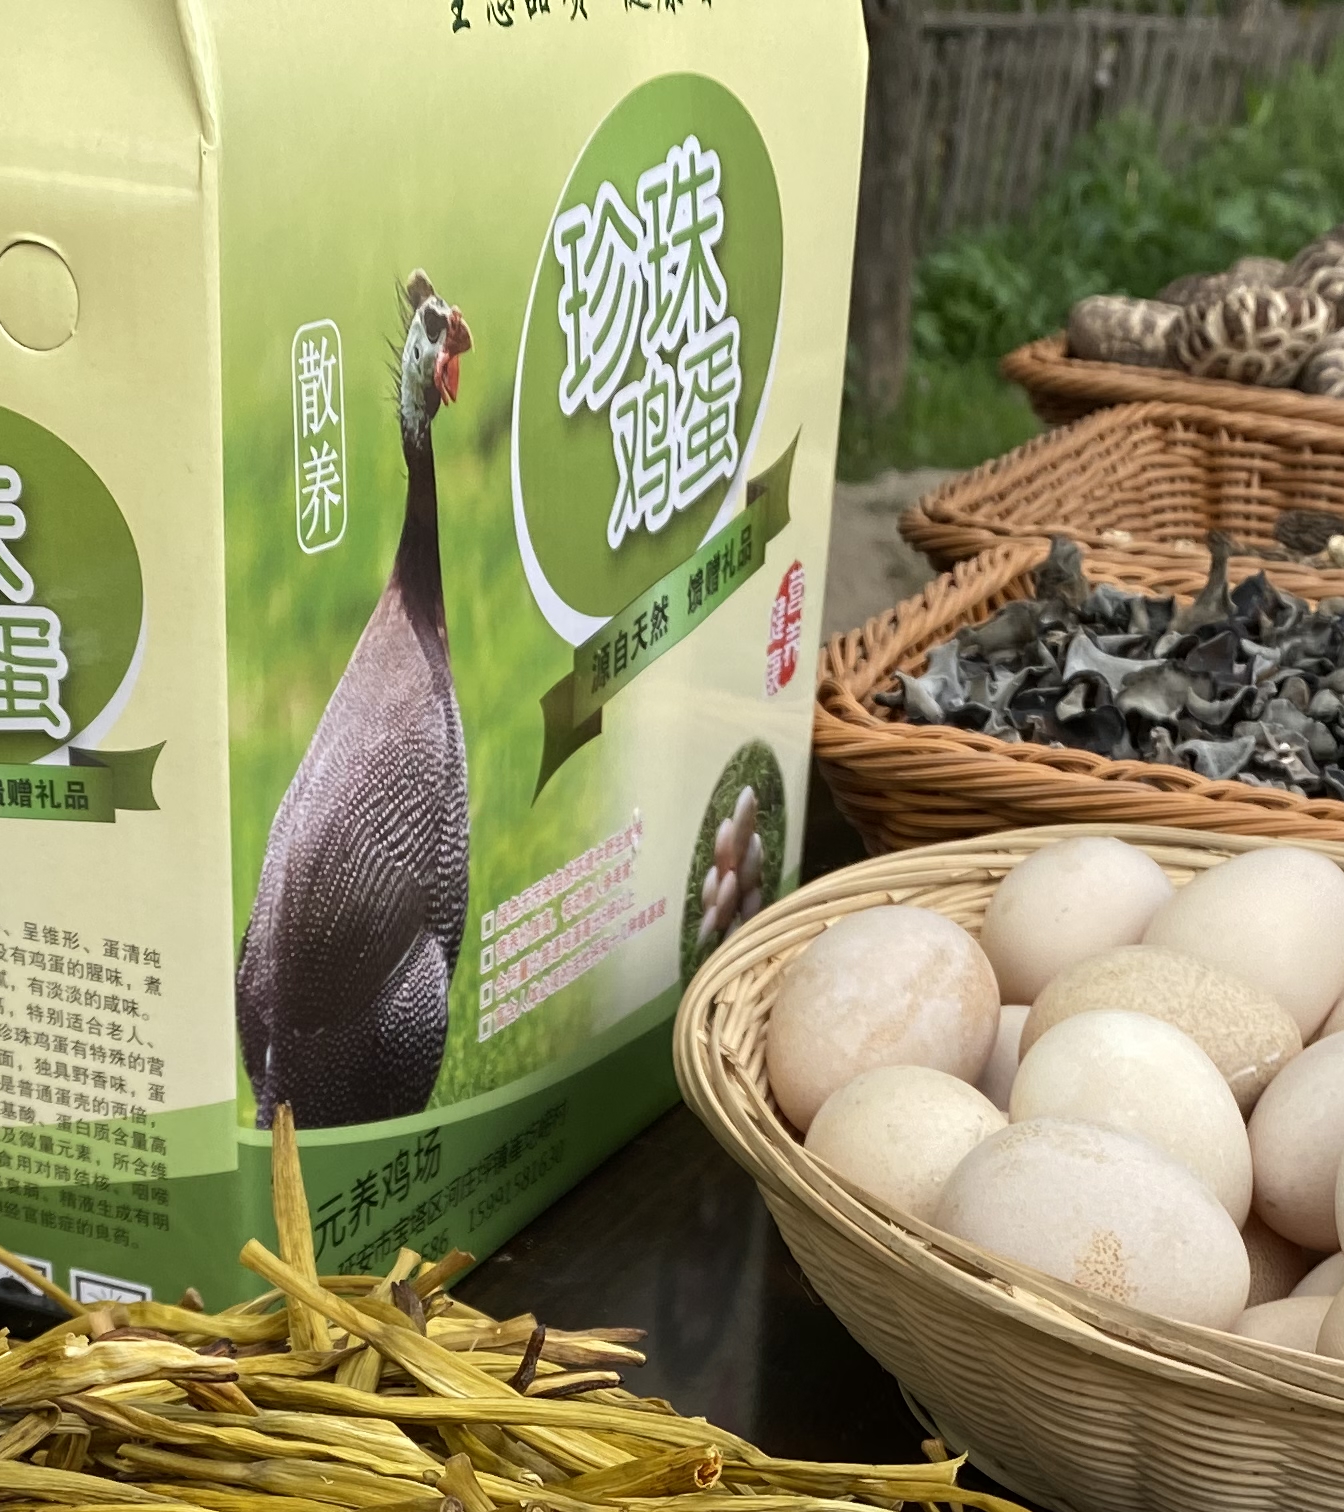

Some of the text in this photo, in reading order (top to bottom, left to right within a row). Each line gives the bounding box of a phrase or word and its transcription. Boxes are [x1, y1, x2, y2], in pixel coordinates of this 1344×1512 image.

[299, 336, 341, 540] 散养
[592, 595, 669, 694] 源自天然
